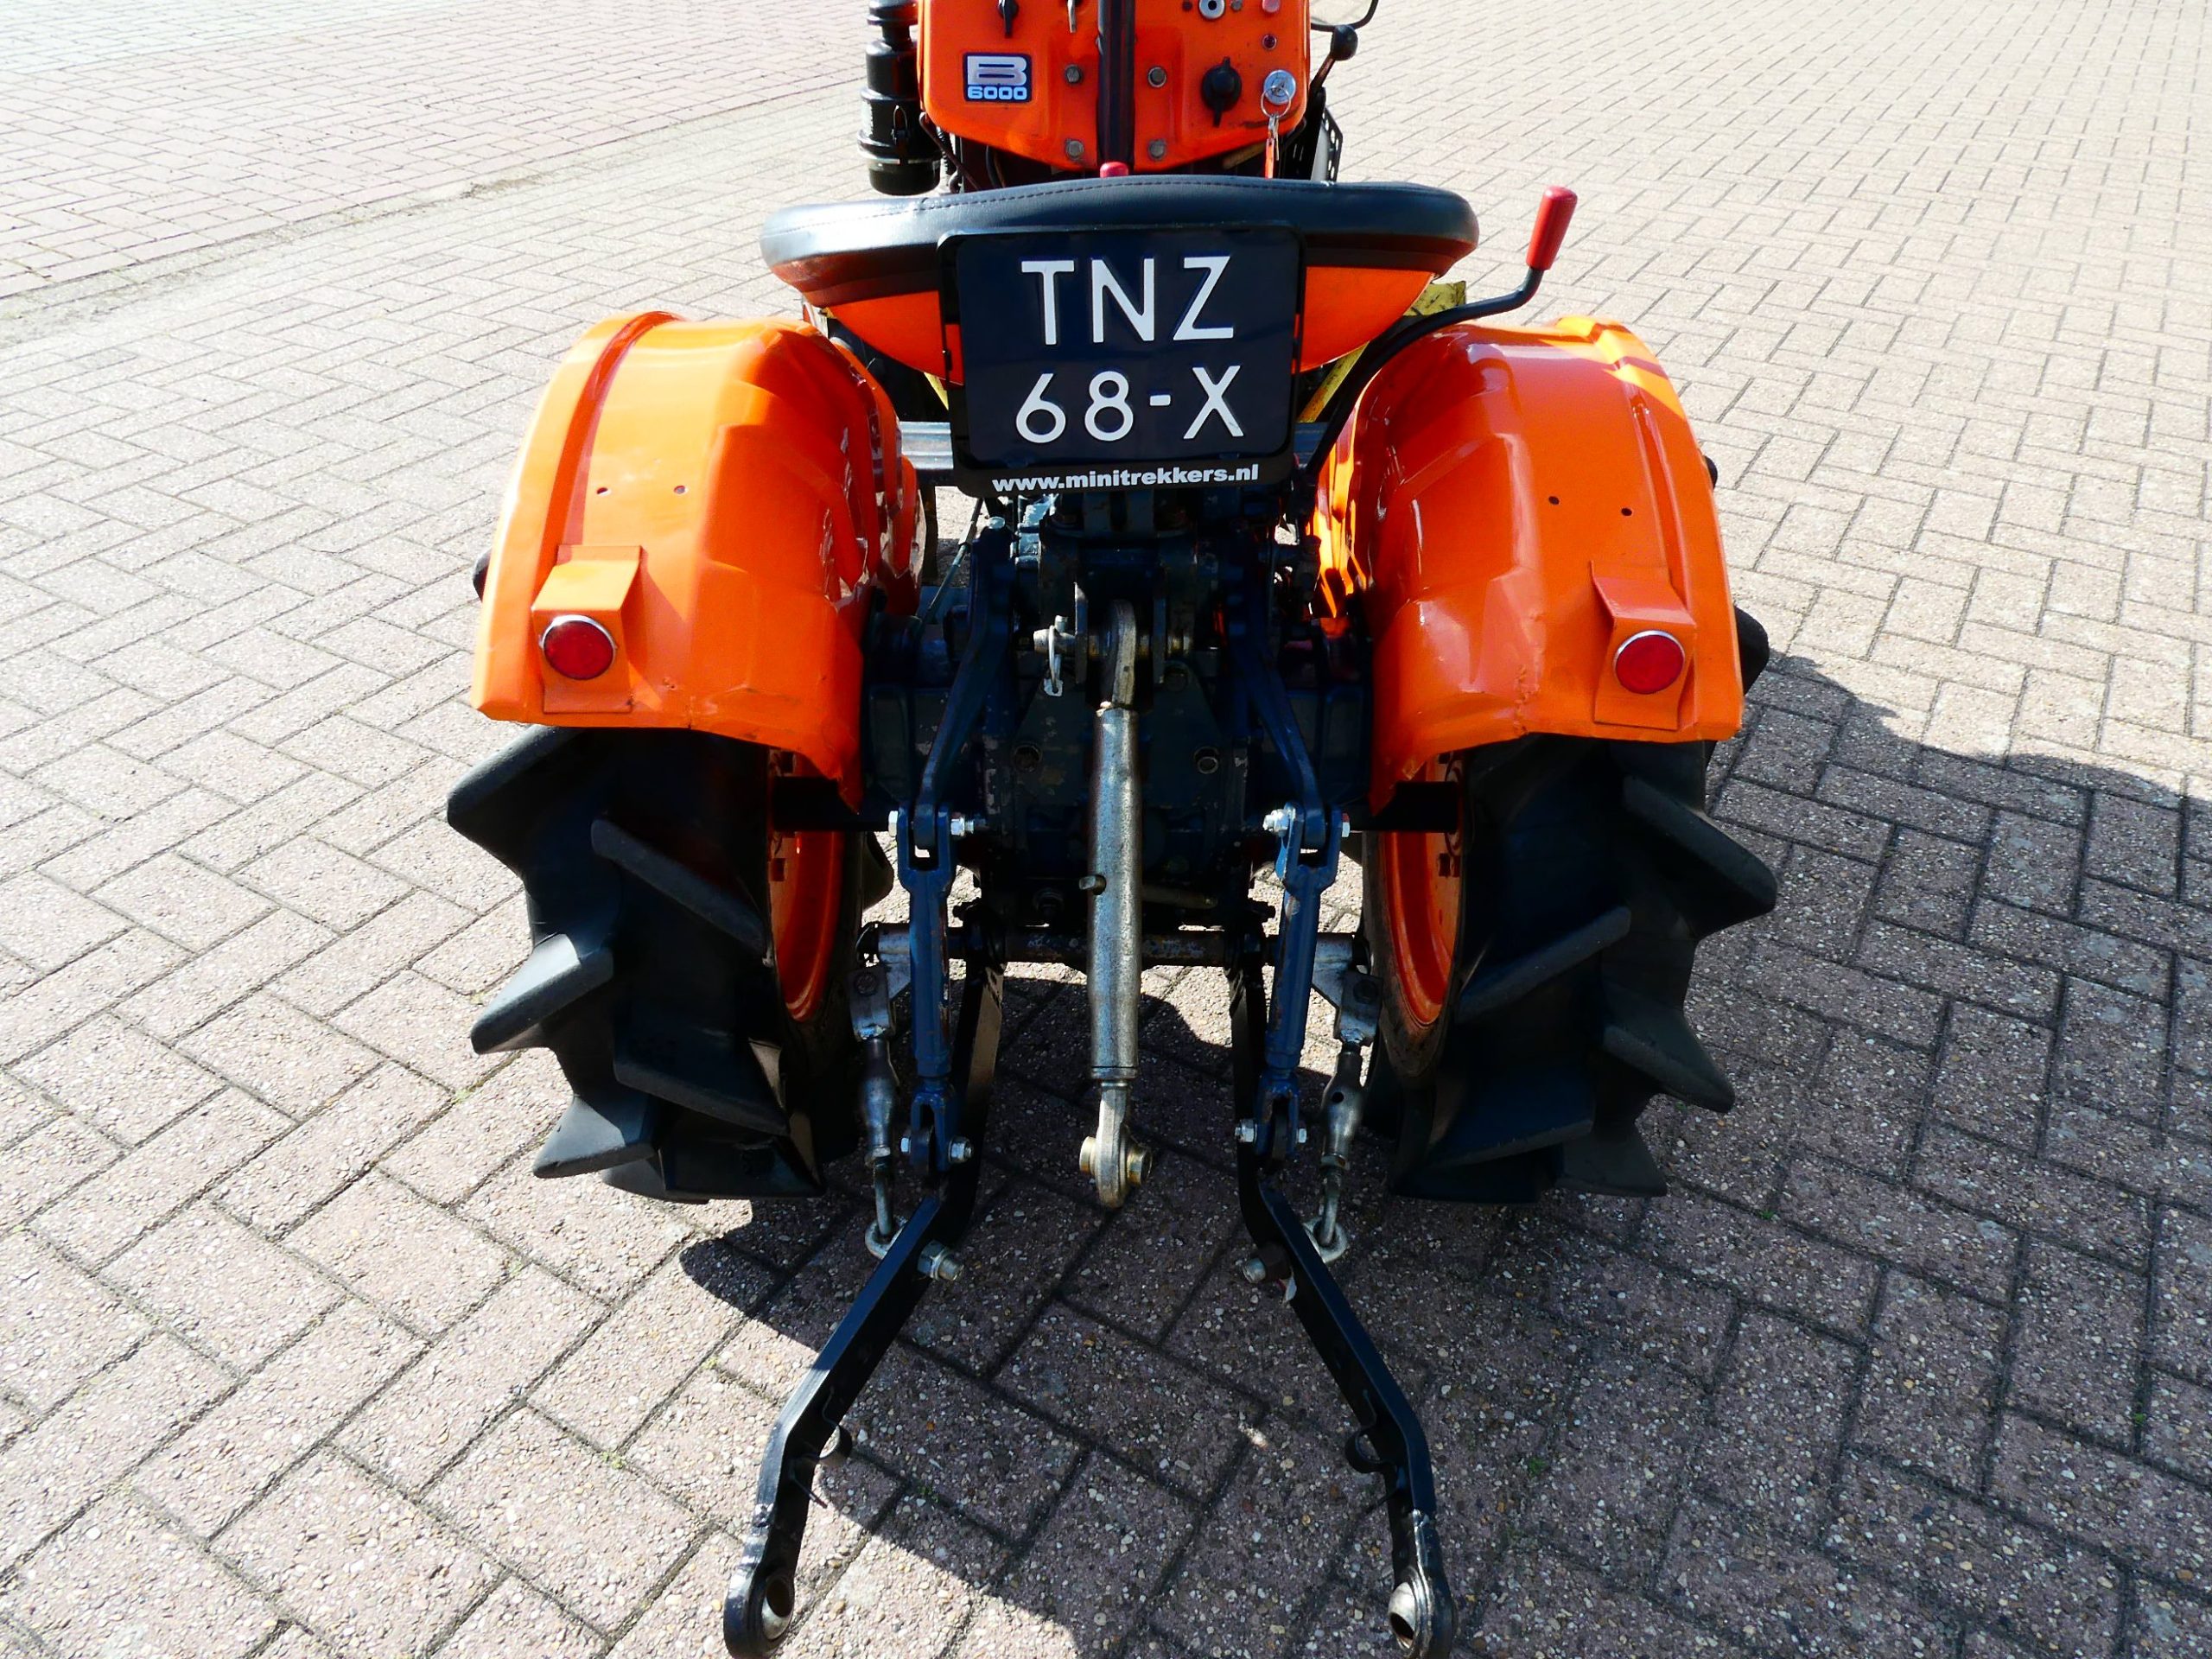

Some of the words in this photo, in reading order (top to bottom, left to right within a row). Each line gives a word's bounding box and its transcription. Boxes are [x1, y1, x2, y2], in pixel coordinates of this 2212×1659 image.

[967, 55, 1027, 86] B
[967, 86, 1027, 100] 6000
[1020, 256, 1234, 345] TNZ
[1015, 365, 1244, 443] 68-X
[992, 464, 1259, 492] www.minitrekkers.nl
